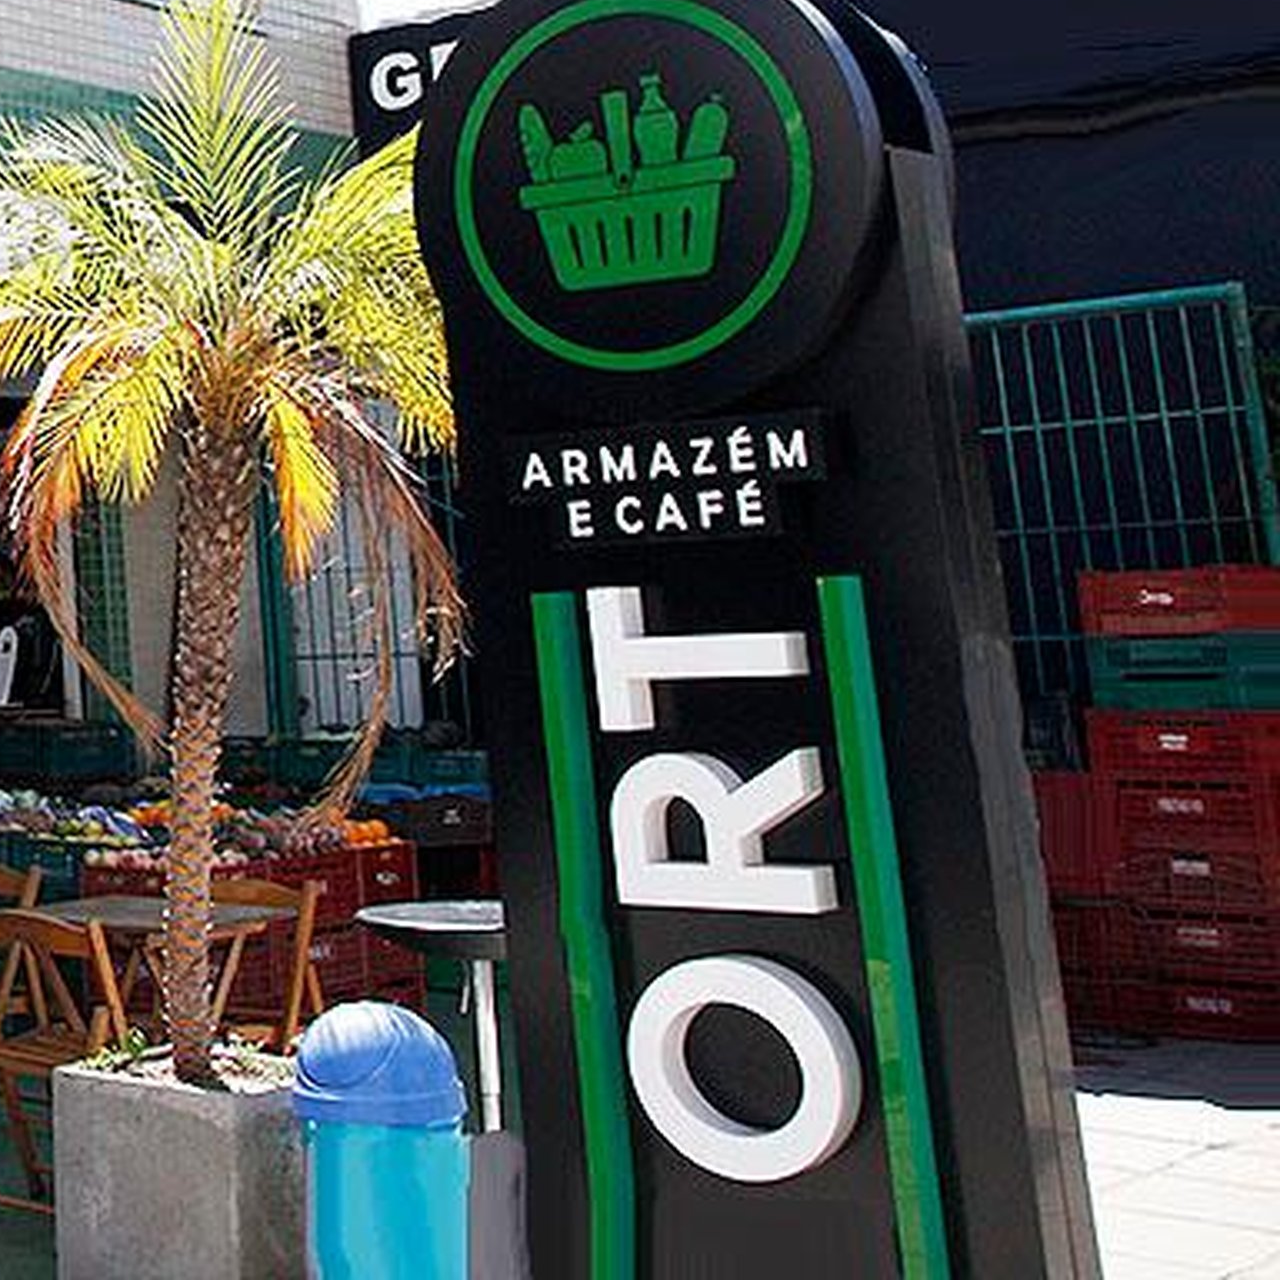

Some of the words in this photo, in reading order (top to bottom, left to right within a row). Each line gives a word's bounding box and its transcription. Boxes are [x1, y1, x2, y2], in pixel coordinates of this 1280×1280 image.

[521, 425, 809, 491] ARMAZÉM
[566, 499, 595, 538] E
[614, 478, 766, 535] CAFÉ
